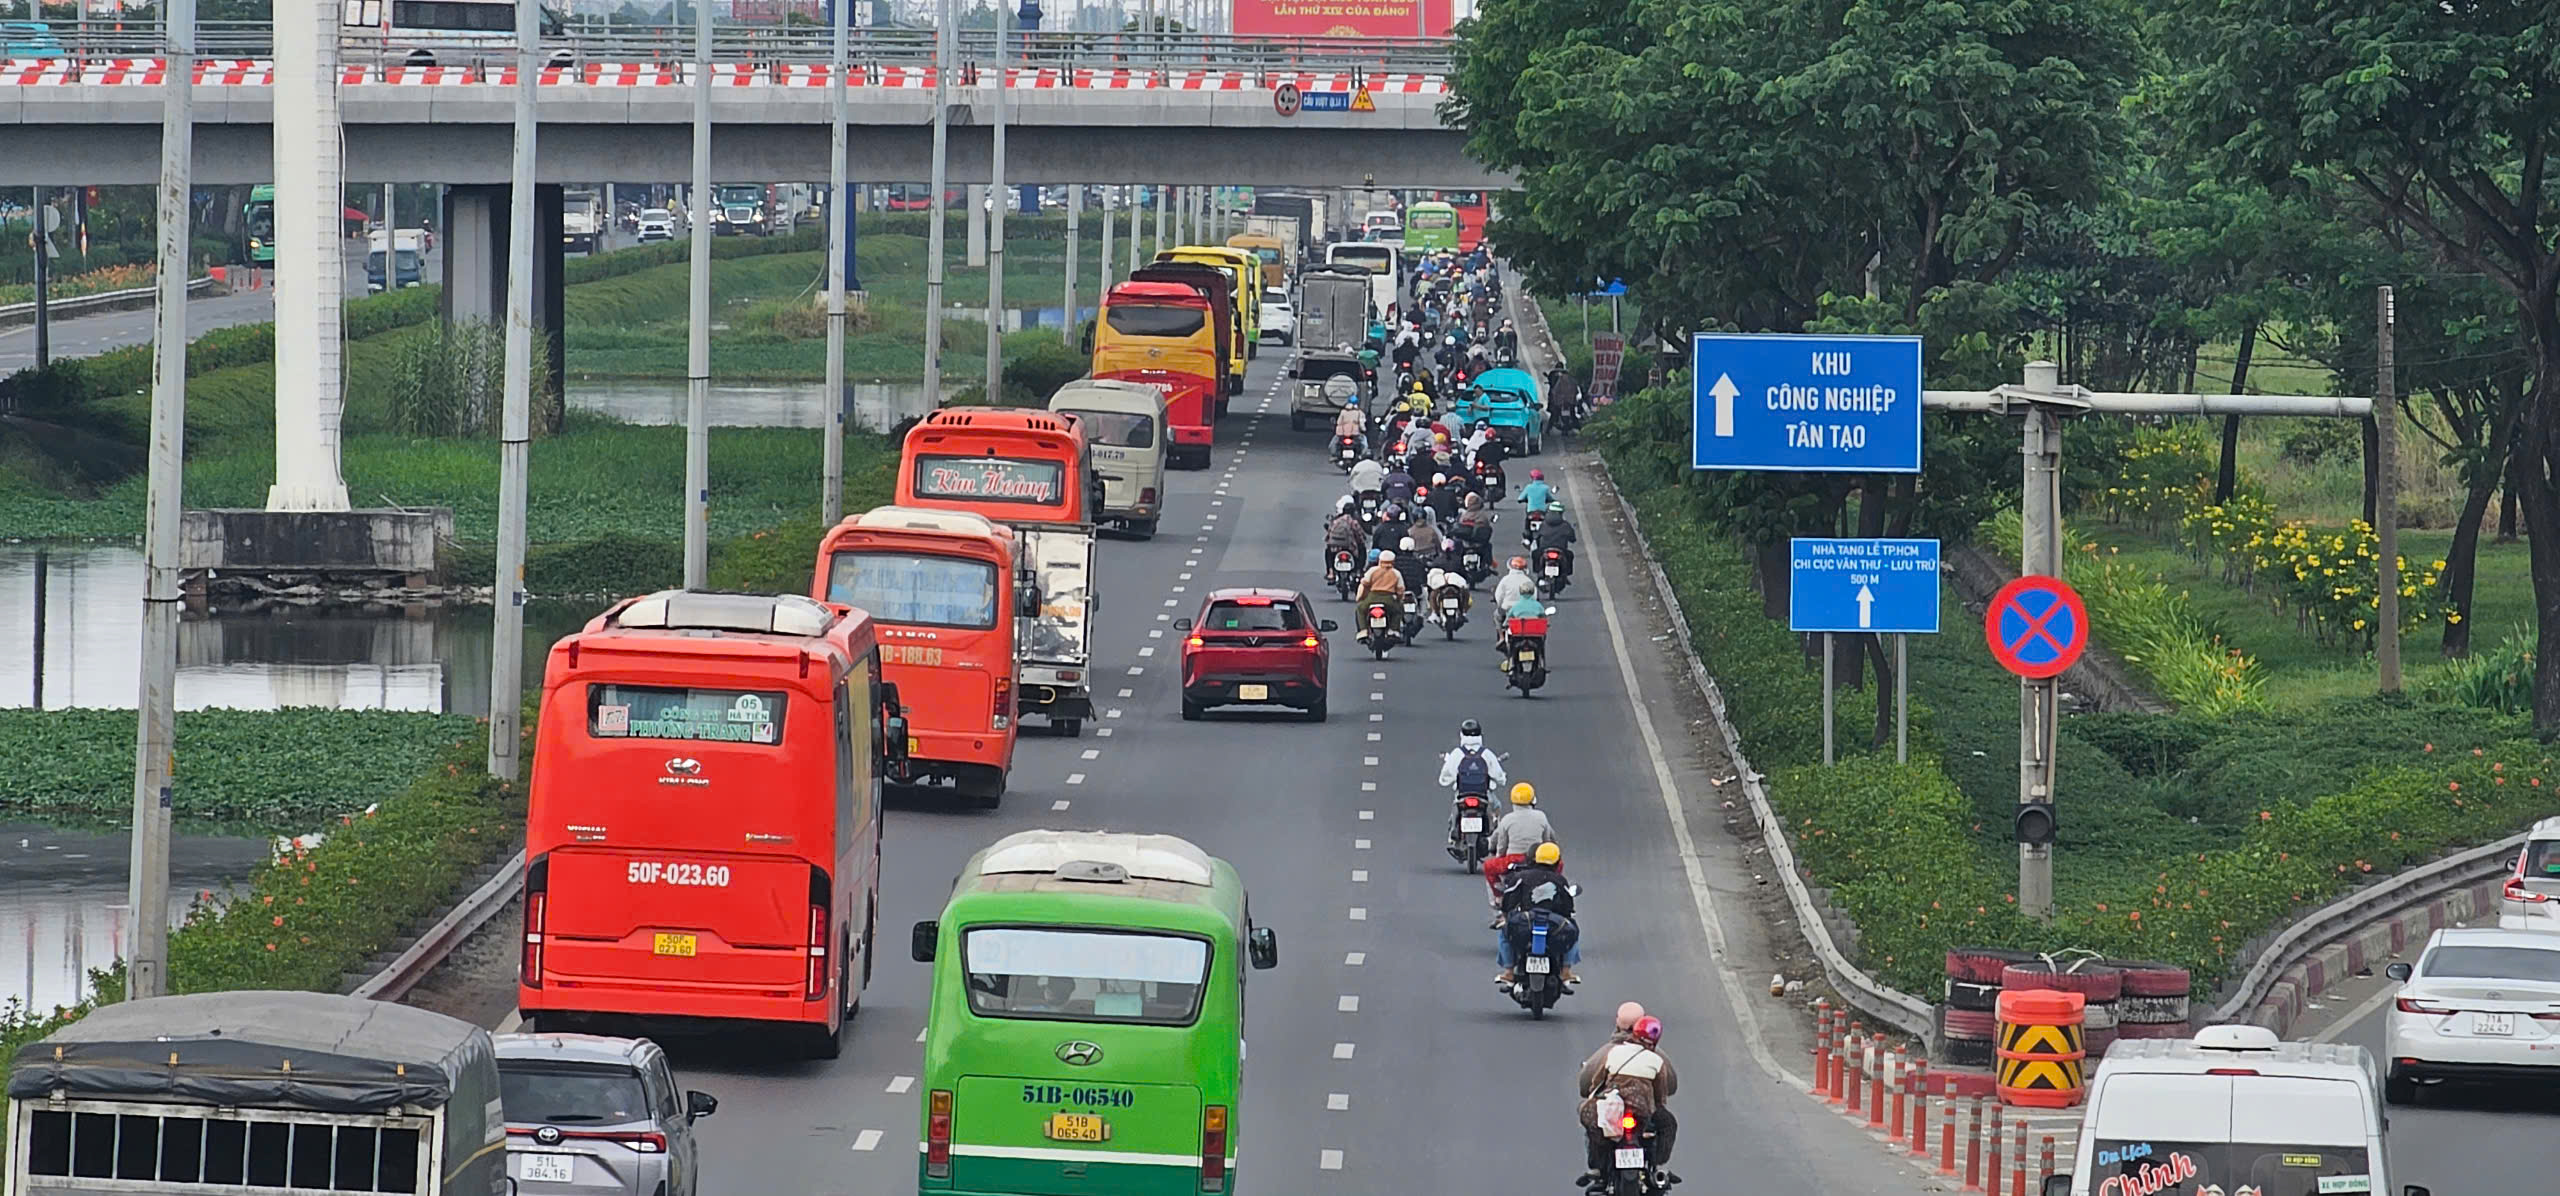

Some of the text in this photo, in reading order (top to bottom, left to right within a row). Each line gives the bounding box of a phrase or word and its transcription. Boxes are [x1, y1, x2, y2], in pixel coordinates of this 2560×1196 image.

[1274, 3, 1297, 15] LẦN
[1300, 5, 1320, 15] THỨ
[1345, 5, 1370, 16] CỦA
[1812, 352, 1851, 376] KHU
[1766, 383, 1896, 415] CÔNG NGHIỆP
[1785, 421, 1866, 452] TÂN TẠO
[928, 467, 1050, 502] Kim Hoàng
[1812, 542, 1835, 555] NHÀ
[1883, 545, 1919, 556] TP.HCM
[1794, 560, 1811, 570] CHI
[1813, 560, 1834, 572] CỤC
[1836, 557, 1858, 570] VĂN
[1860, 560, 1881, 570] THƯ
[1915, 559, 1936, 571] TRỮ
[1850, 574, 1879, 584] 500 M
[741, 698, 757, 709] 05
[629, 719, 693, 739] PHƯƠNG
[699, 723, 751, 741] TRANG
[627, 862, 729, 887] 50F-023.60
[1023, 1085, 1133, 1108] 51B-06540
[1066, 1116, 1088, 1127] 51B
[536, 1156, 558, 1167] 51L
[2098, 1142, 2152, 1166] Du Lịch
[527, 1168, 567, 1179] 384.16
